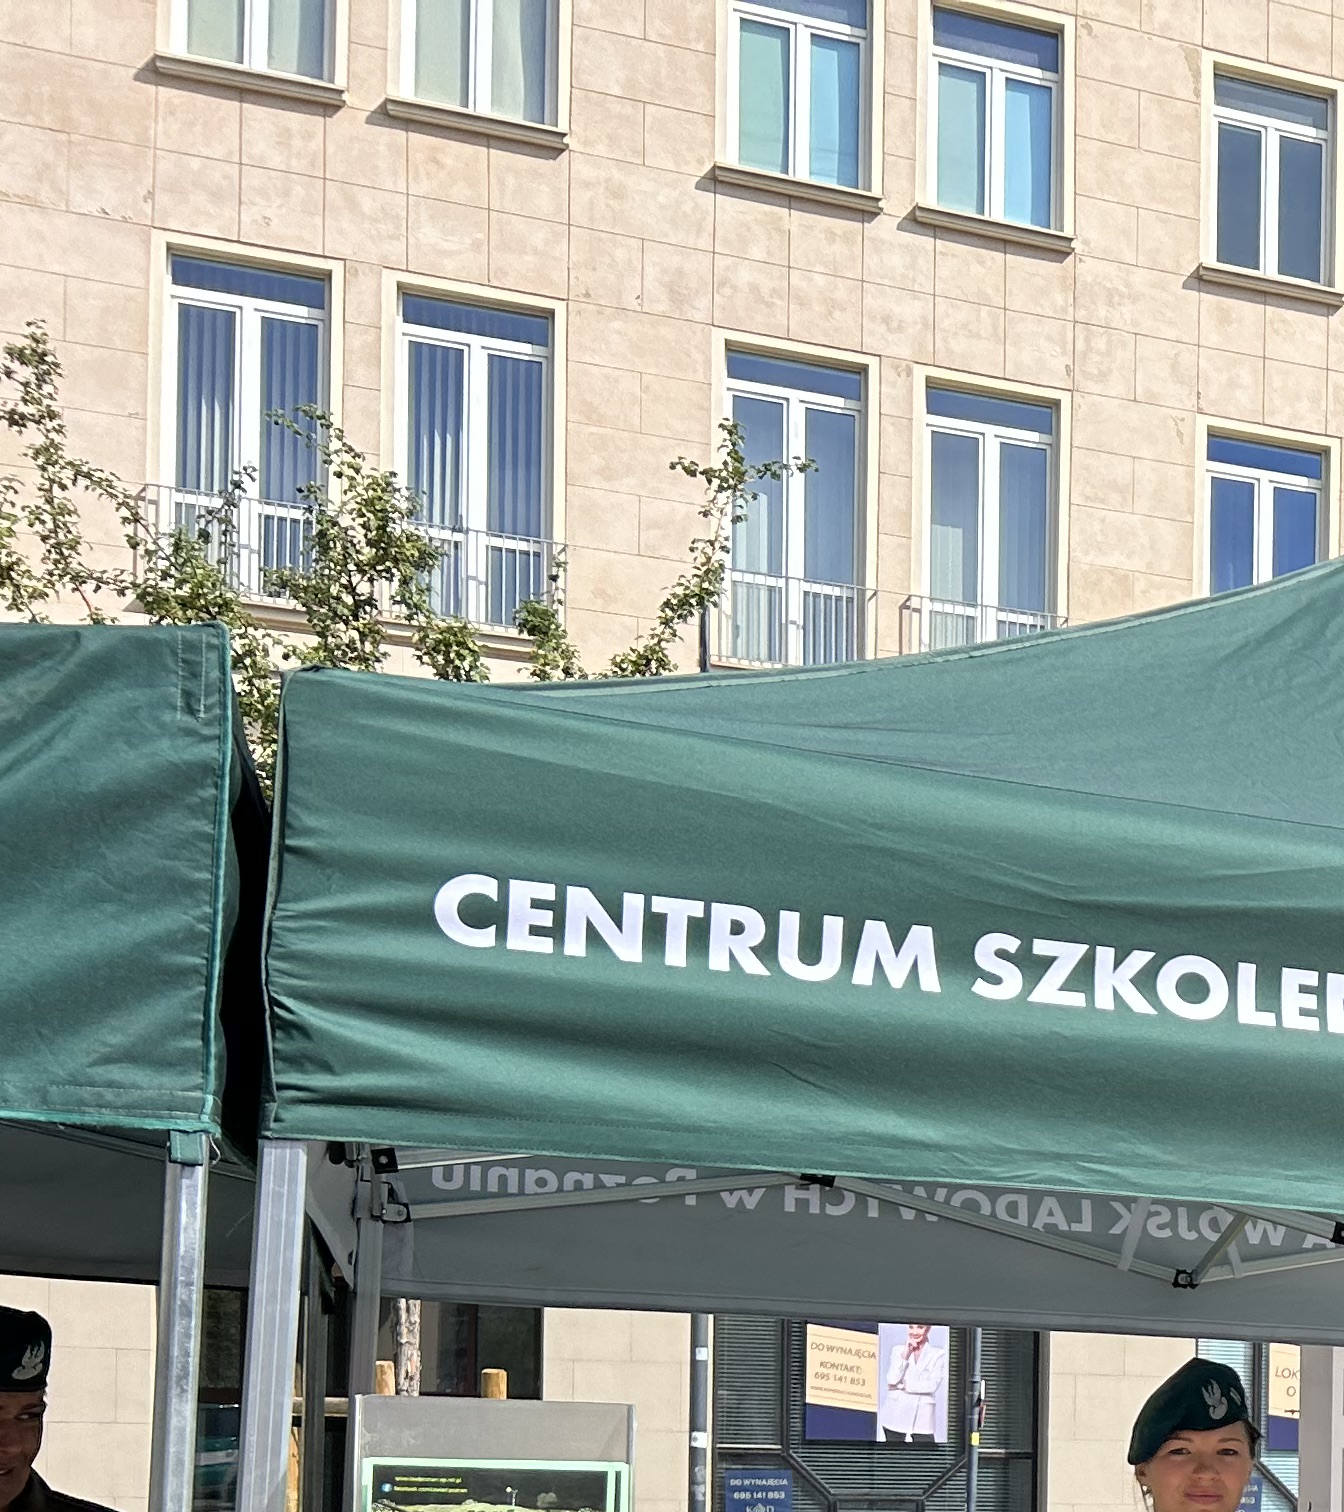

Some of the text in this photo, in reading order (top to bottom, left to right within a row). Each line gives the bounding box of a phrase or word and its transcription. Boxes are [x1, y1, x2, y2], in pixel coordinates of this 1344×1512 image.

[433, 872, 942, 995] CENTRUM
[811, 1342, 825, 1352] DO
[814, 1372, 831, 1382] 695
[833, 1374, 848, 1384] 141
